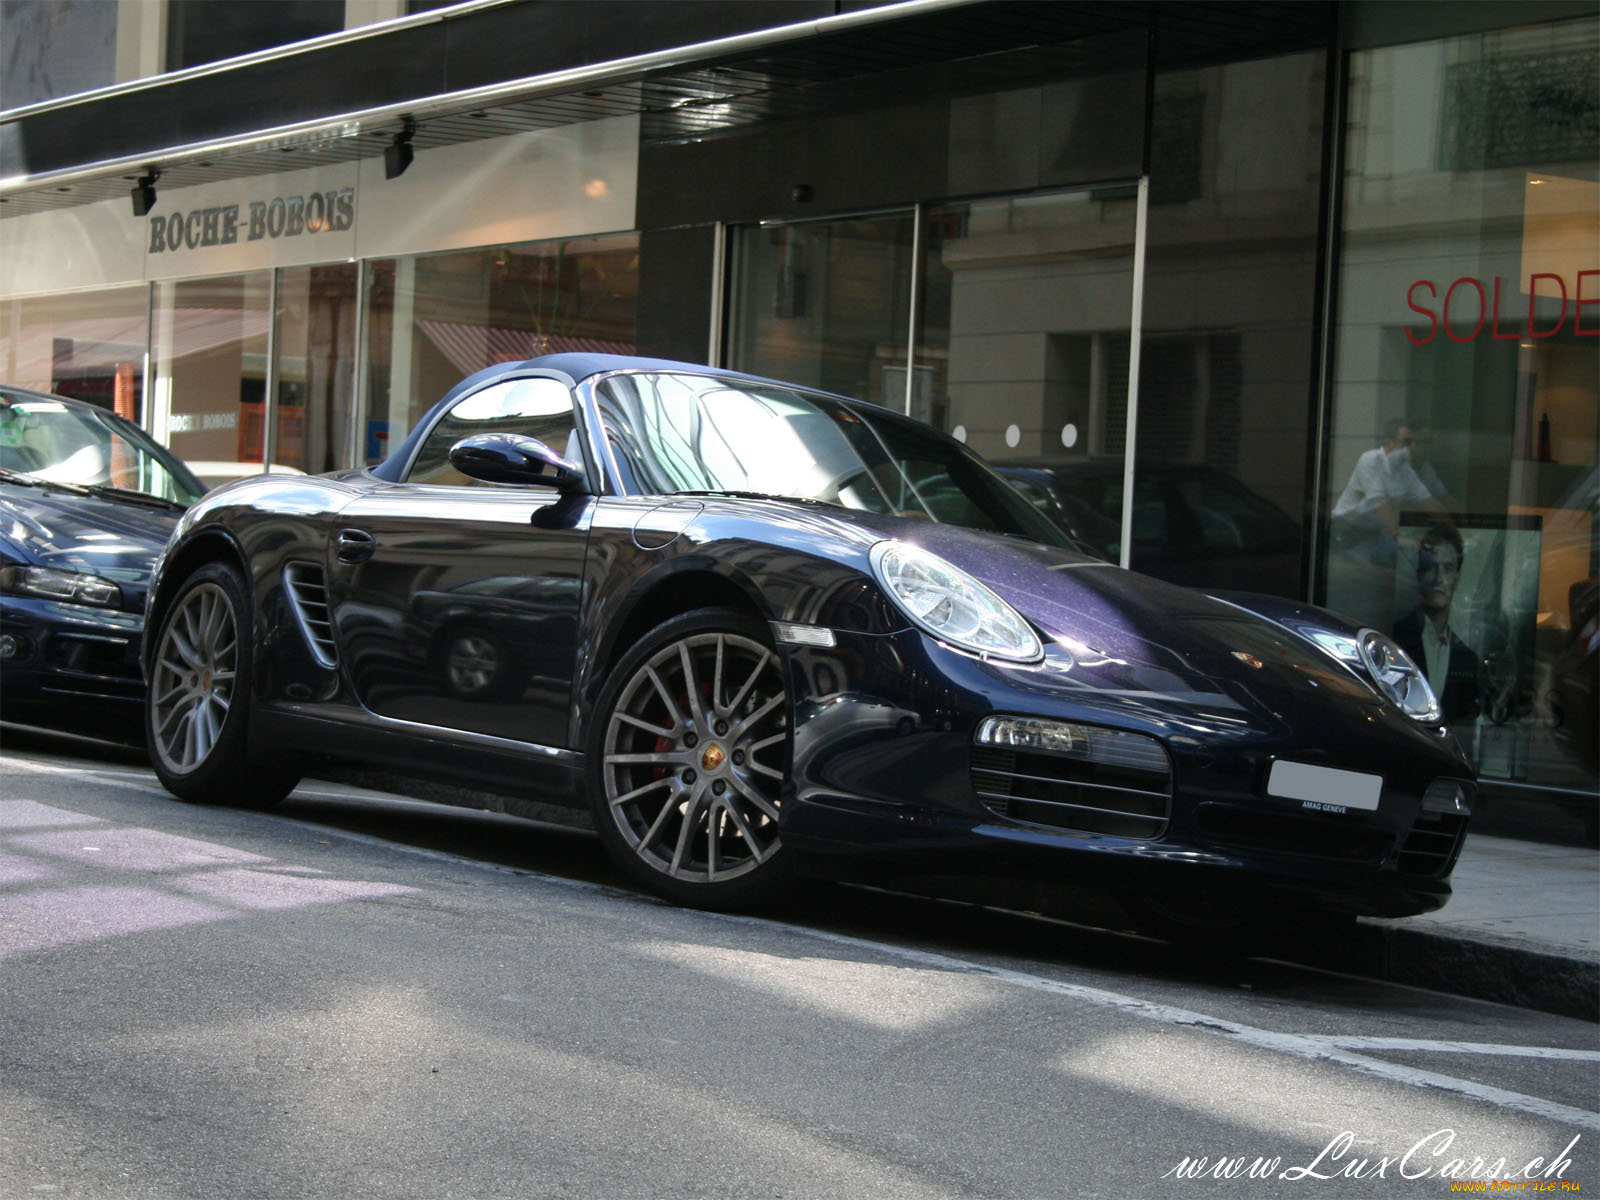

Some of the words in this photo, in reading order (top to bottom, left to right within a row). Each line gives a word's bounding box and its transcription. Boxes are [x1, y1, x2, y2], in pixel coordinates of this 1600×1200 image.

[149, 187, 354, 254] ROCHE-BOBOIS
[1403, 269, 1600, 346] SOLDE
[169, 415, 200, 431] ROC
[1302, 801, 1322, 810] AMAG
